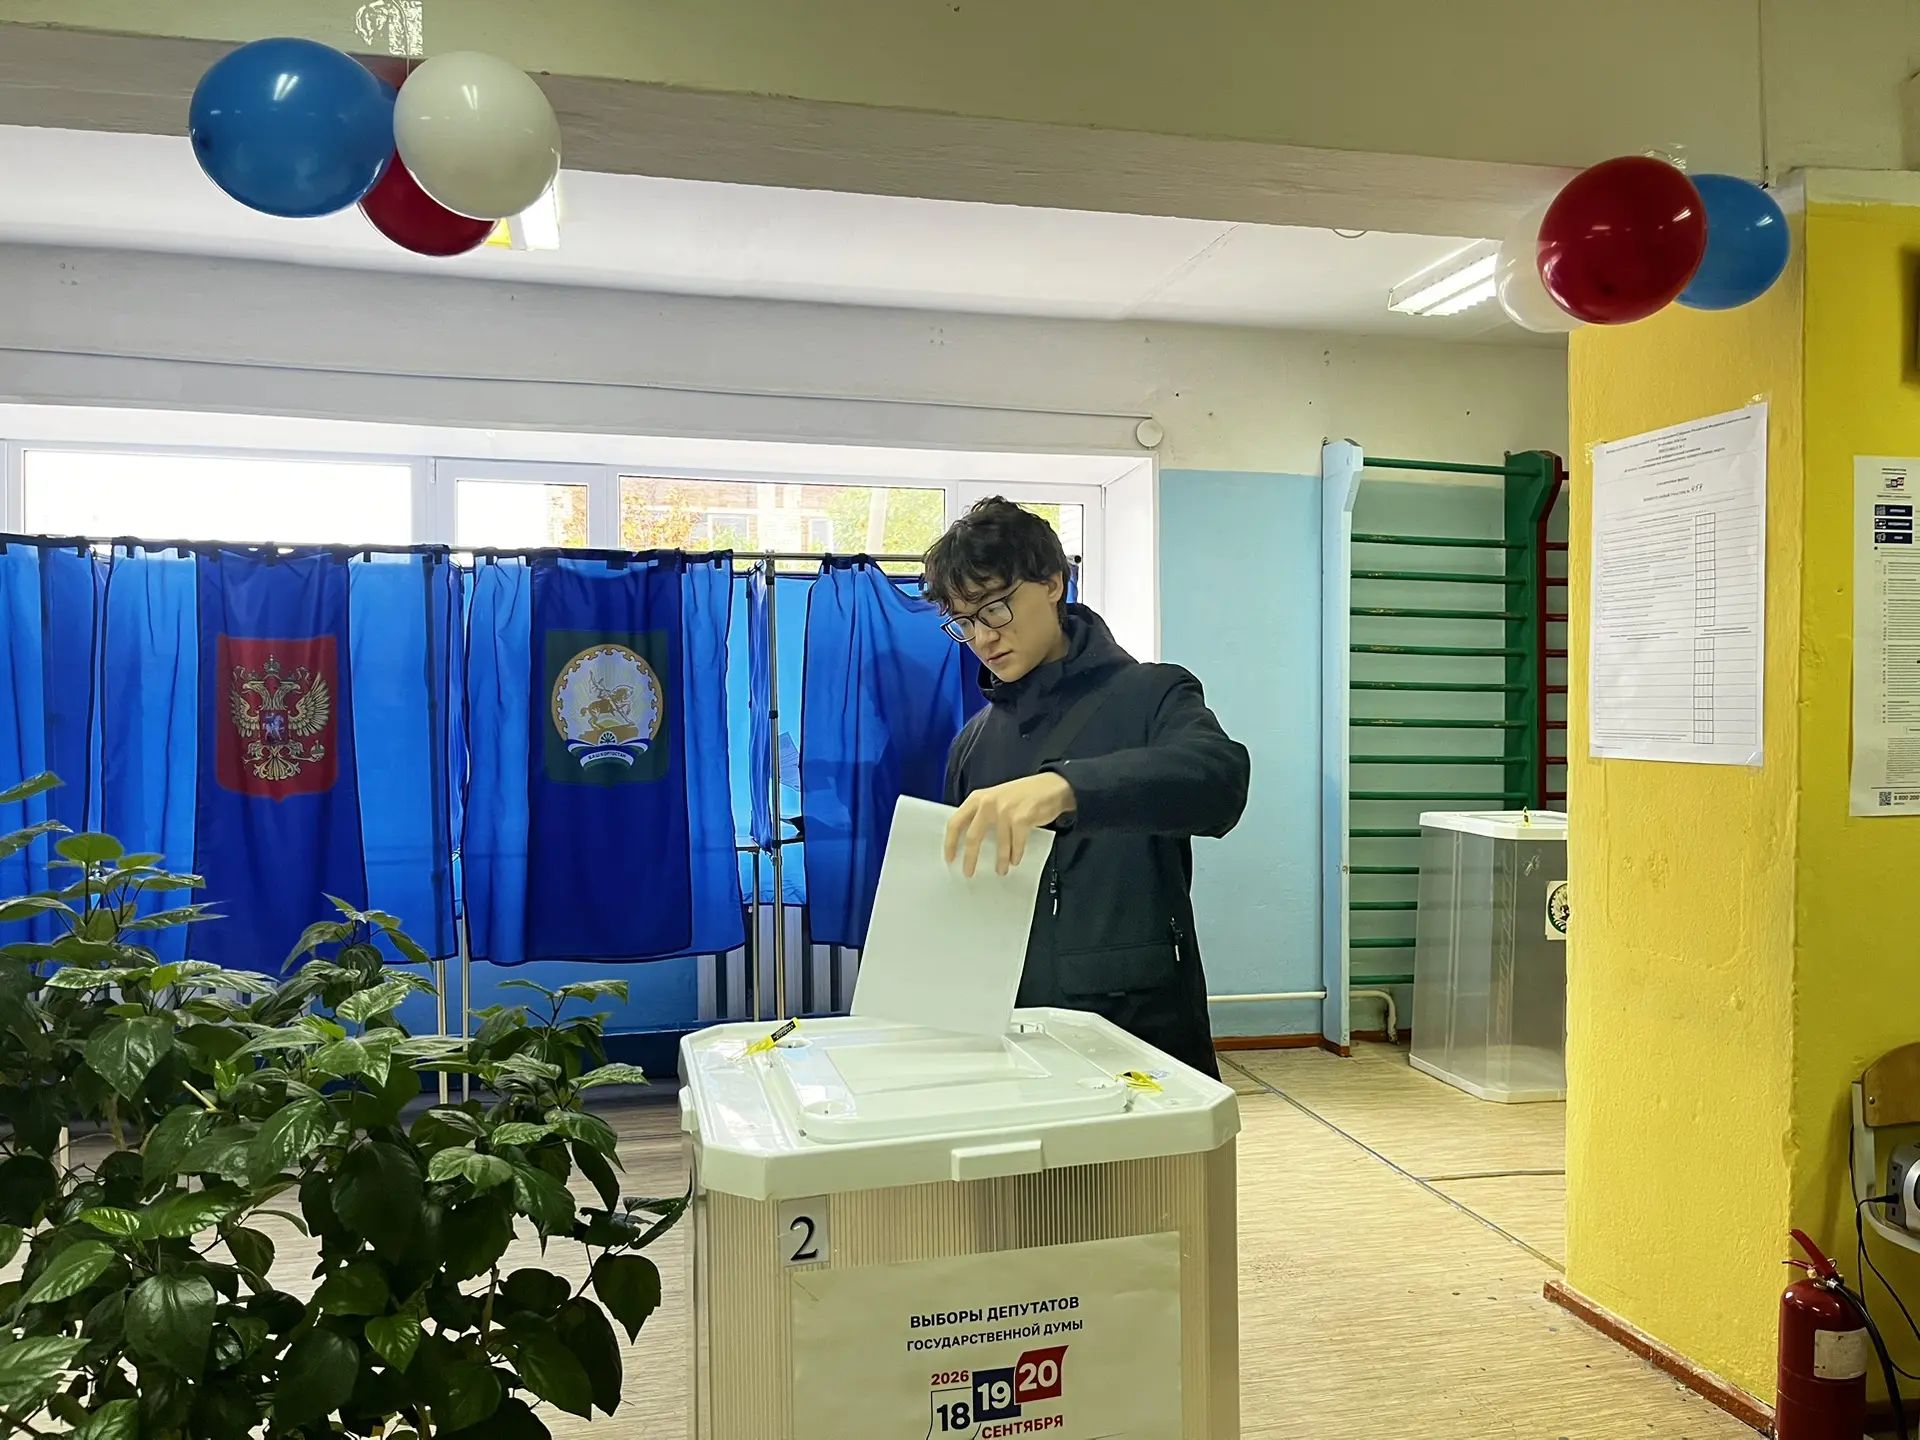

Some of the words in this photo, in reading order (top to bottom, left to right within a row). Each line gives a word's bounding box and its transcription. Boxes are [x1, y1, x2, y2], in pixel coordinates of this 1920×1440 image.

[790, 1216, 818, 1261] 2
[910, 1309, 983, 1328] ВЫБОРЫ
[986, 1296, 1080, 1322] ДЕПУТАТОВ
[907, 1323, 1041, 1351] ГОСУДАРСТВЕННОЙ
[1043, 1319, 1083, 1336] ДУМЫ
[930, 1370, 970, 1386] 2026
[1019, 1359, 1059, 1392] 20
[977, 1380, 1012, 1411] 19
[936, 1402, 971, 1432] 18
[981, 1415, 1064, 1440] СЕНТЯБРЯ
